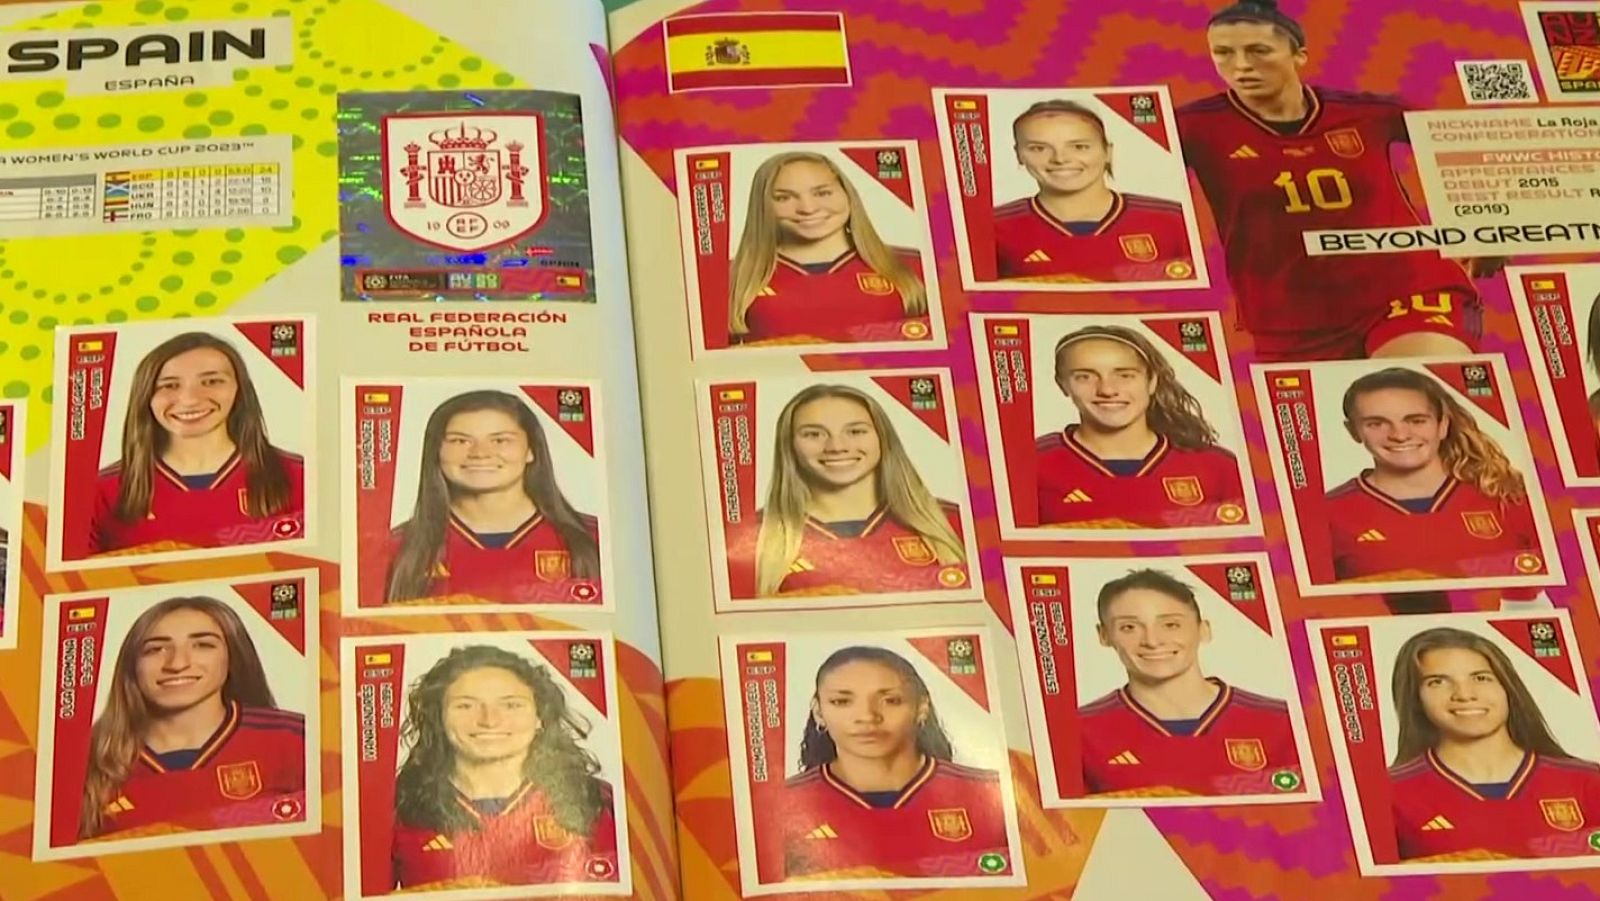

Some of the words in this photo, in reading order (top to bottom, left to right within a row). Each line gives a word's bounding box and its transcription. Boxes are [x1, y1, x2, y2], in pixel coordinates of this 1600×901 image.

[7, 28, 265, 73] SPAIN
[104, 75, 195, 91] ESPAÑA
[1561, 80, 1600, 91] SPA
[1427, 119, 1531, 130] NICKNAME
[1537, 118, 1557, 127] La
[1561, 117, 1598, 128] Roja
[11, 153, 89, 164] WOMEN'S
[94, 147, 153, 160] WORLD
[157, 145, 192, 155] CUP
[1483, 152, 1546, 163] FWWC
[1441, 164, 1595, 178] APPEARANCES
[1444, 179, 1512, 190] DEBUT
[1518, 178, 1559, 188] 2015
[1273, 168, 1352, 213] 10
[1446, 190, 1501, 203] BEST
[1506, 188, 1585, 200] RESULT
[1454, 203, 1510, 217] (2019)
[1320, 227, 1466, 251] BEYOND
[368, 313, 424, 323] REAL
[430, 310, 567, 324] FEDERACIÓN
[409, 325, 527, 337] ESPAÑOLA
[409, 341, 438, 352] DE
[444, 338, 529, 352] FÚTBOL
[718, 417, 735, 458] CASTILLO
[724, 460, 737, 477] DEL
[1289, 452, 1307, 488] TERESA
[725, 478, 741, 523] ATHENEA
[1030, 602, 1051, 654] GONZÁLEZ
[62, 638, 77, 689] CARMONA
[1041, 655, 1059, 694] ESTHER
[1334, 665, 1355, 712] REDONDO
[60, 690, 74, 718] OLGA
[358, 684, 375, 728] ANDRÉS
[1348, 714, 1363, 742] ALBA
[363, 729, 376, 761] IVANA
[752, 745, 767, 782] SALMA
